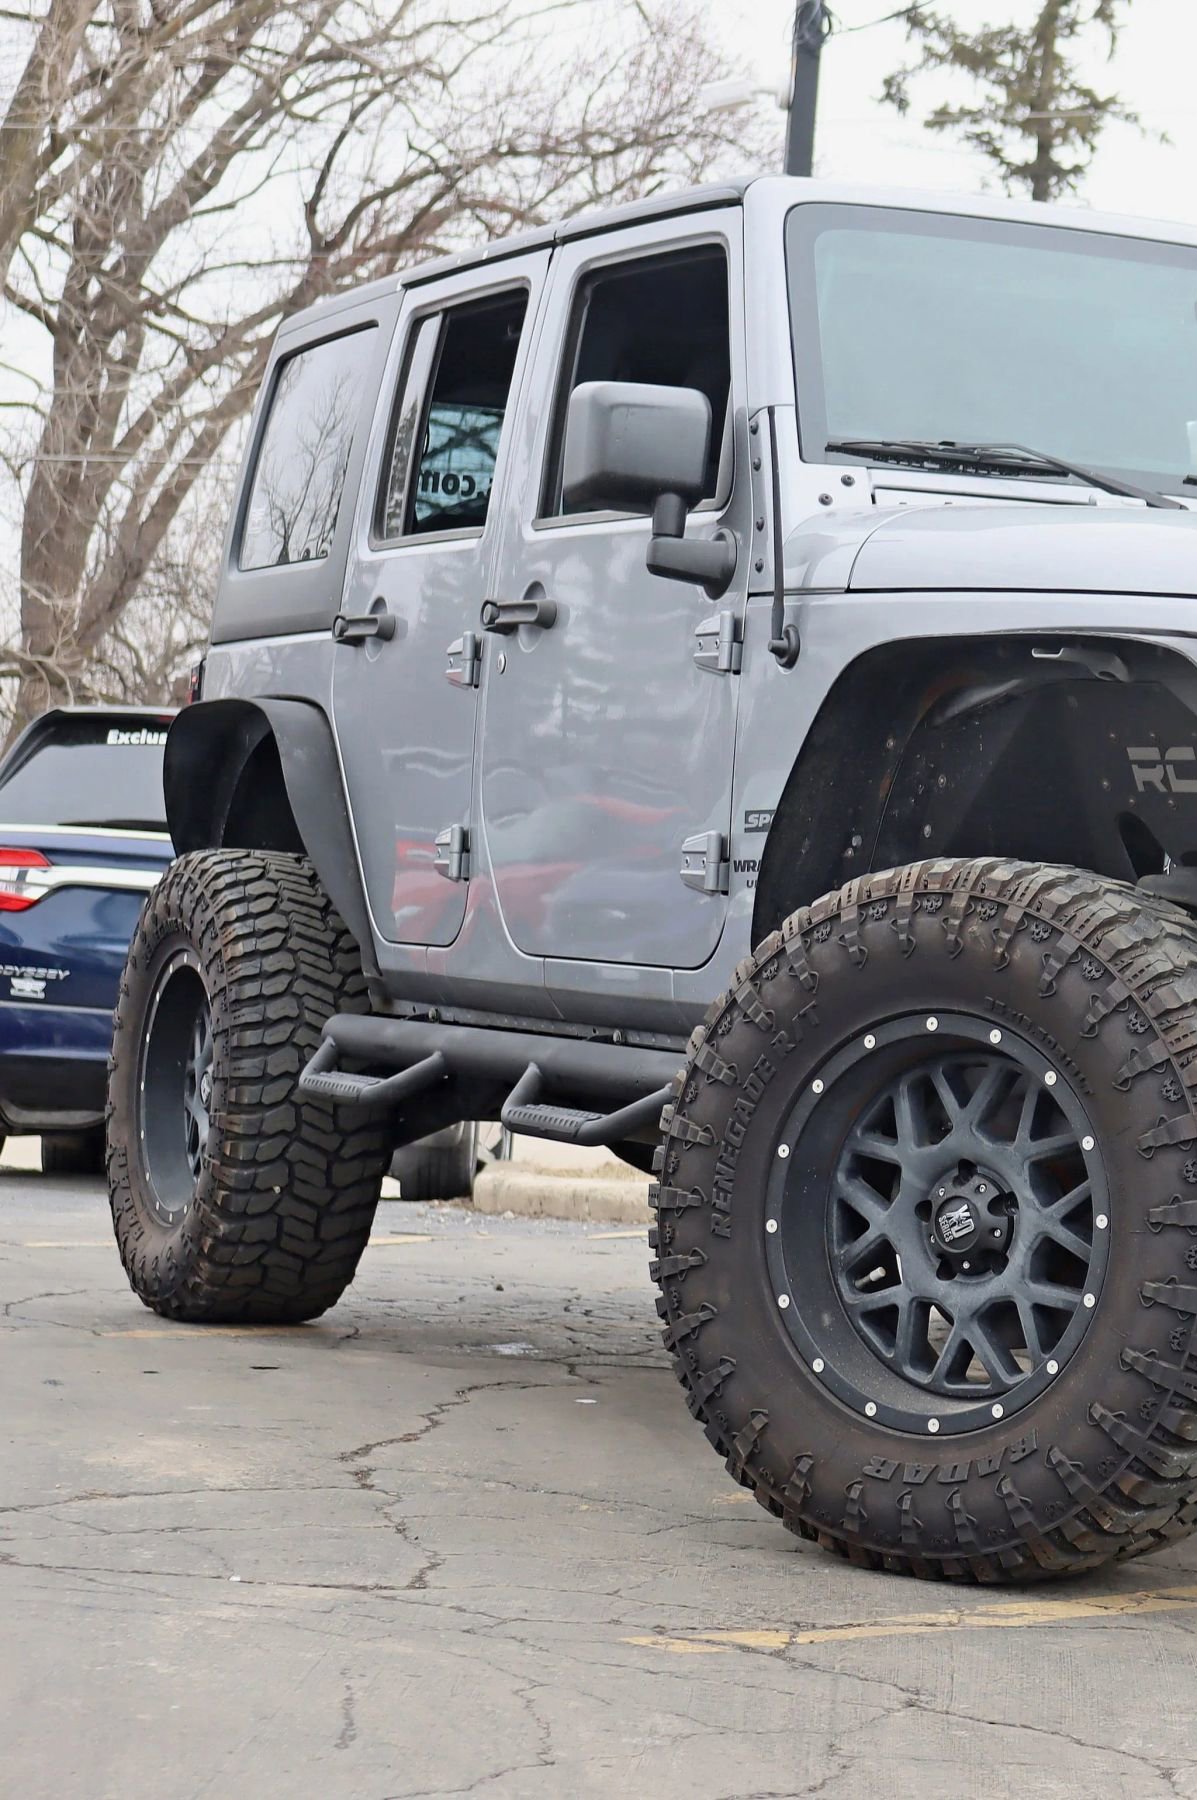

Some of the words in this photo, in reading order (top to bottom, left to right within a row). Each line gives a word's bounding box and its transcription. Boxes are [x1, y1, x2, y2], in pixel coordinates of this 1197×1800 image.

[733, 859, 760, 873] WR
[711, 1054, 776, 1238] RENEGADE
[938, 1215, 954, 1243] SERIES
[862, 1427, 1039, 1485] RADAR
